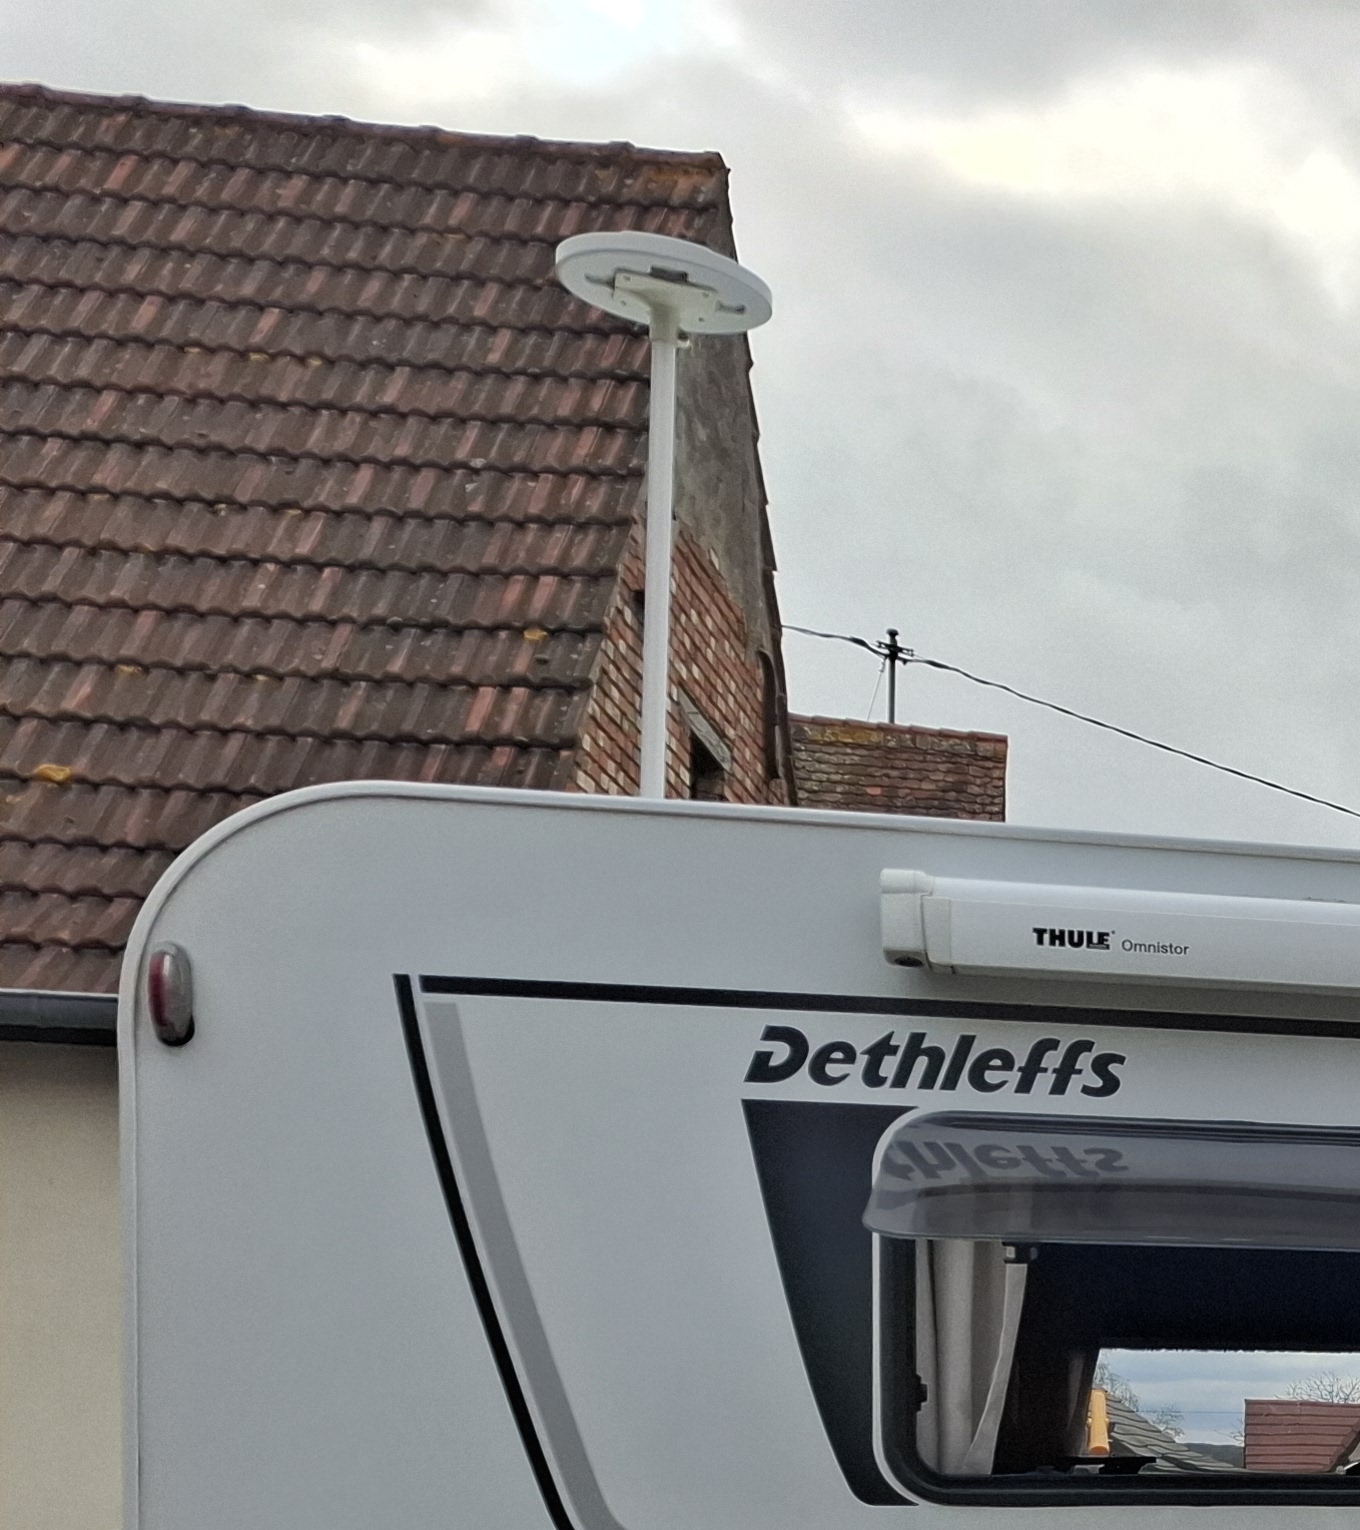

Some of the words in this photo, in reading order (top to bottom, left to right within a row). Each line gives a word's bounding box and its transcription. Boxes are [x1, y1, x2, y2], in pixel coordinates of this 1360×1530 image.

[1032, 927, 1110, 950] THULE
[1121, 939, 1189, 955] Omnistor
[743, 1024, 1127, 1097] Dethleffs
